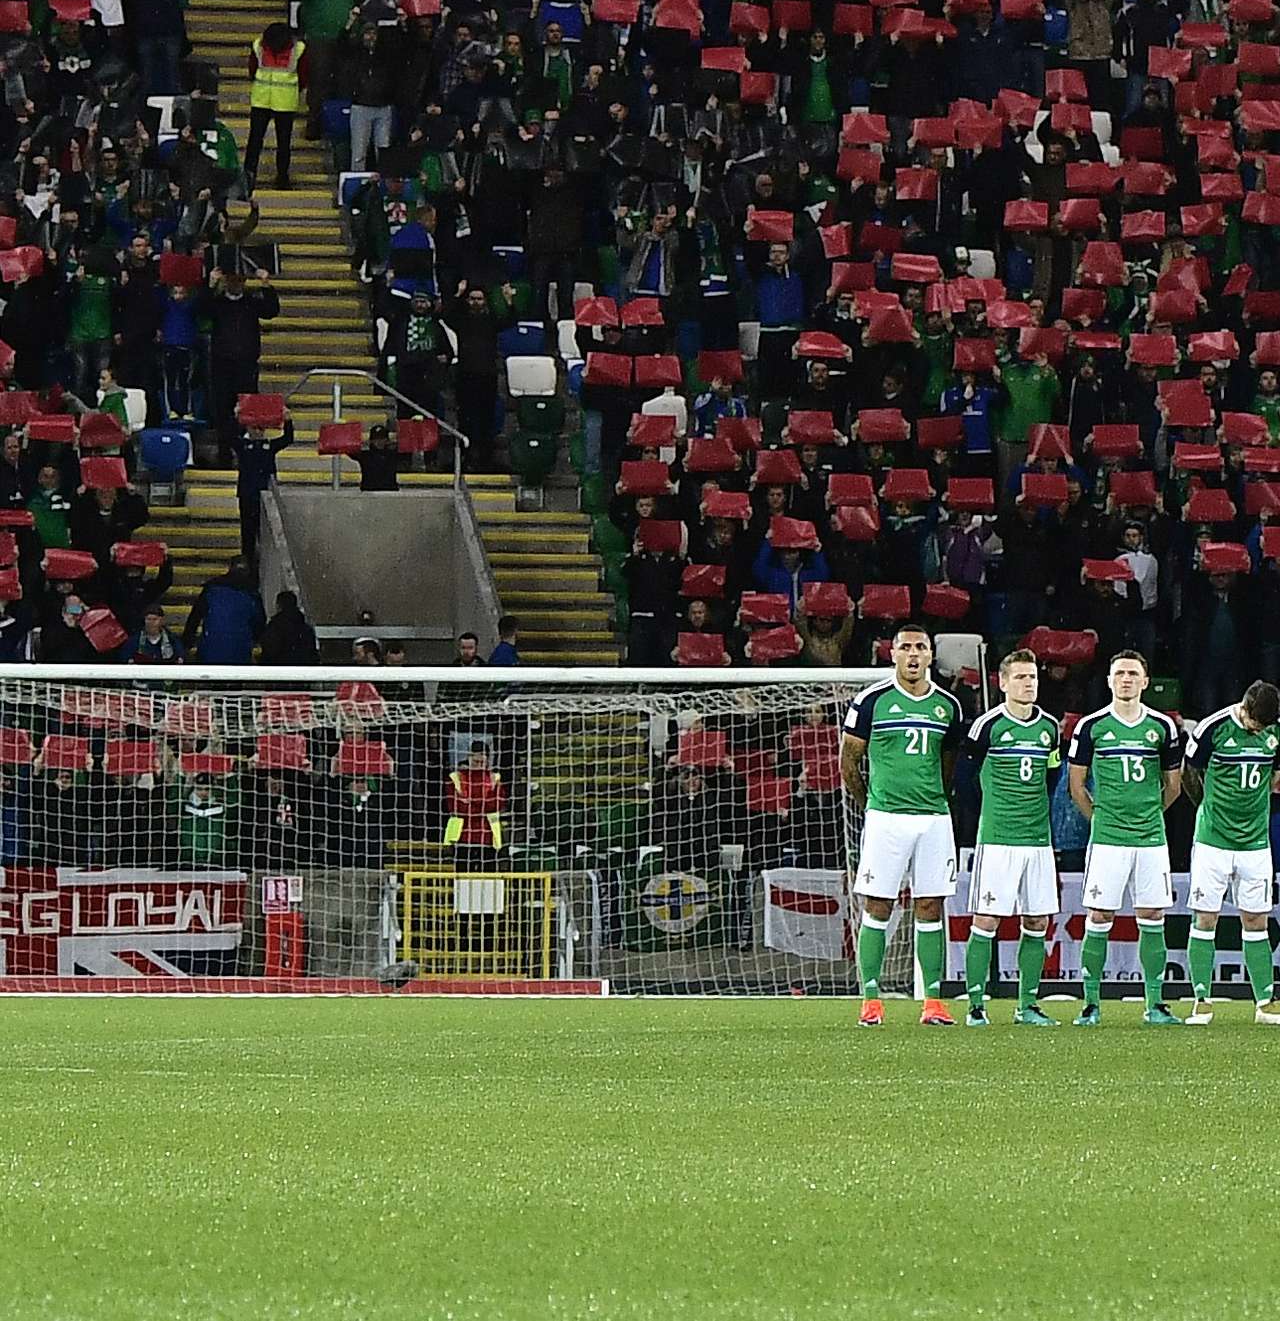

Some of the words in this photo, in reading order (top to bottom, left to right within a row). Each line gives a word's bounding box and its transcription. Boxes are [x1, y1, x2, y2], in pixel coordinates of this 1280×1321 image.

[902, 727, 933, 755] 21
[1019, 756, 1033, 781] 8
[1120, 756, 1146, 782] 13
[1240, 763, 1261, 789] 16
[72, 889, 243, 934] LOYAL
